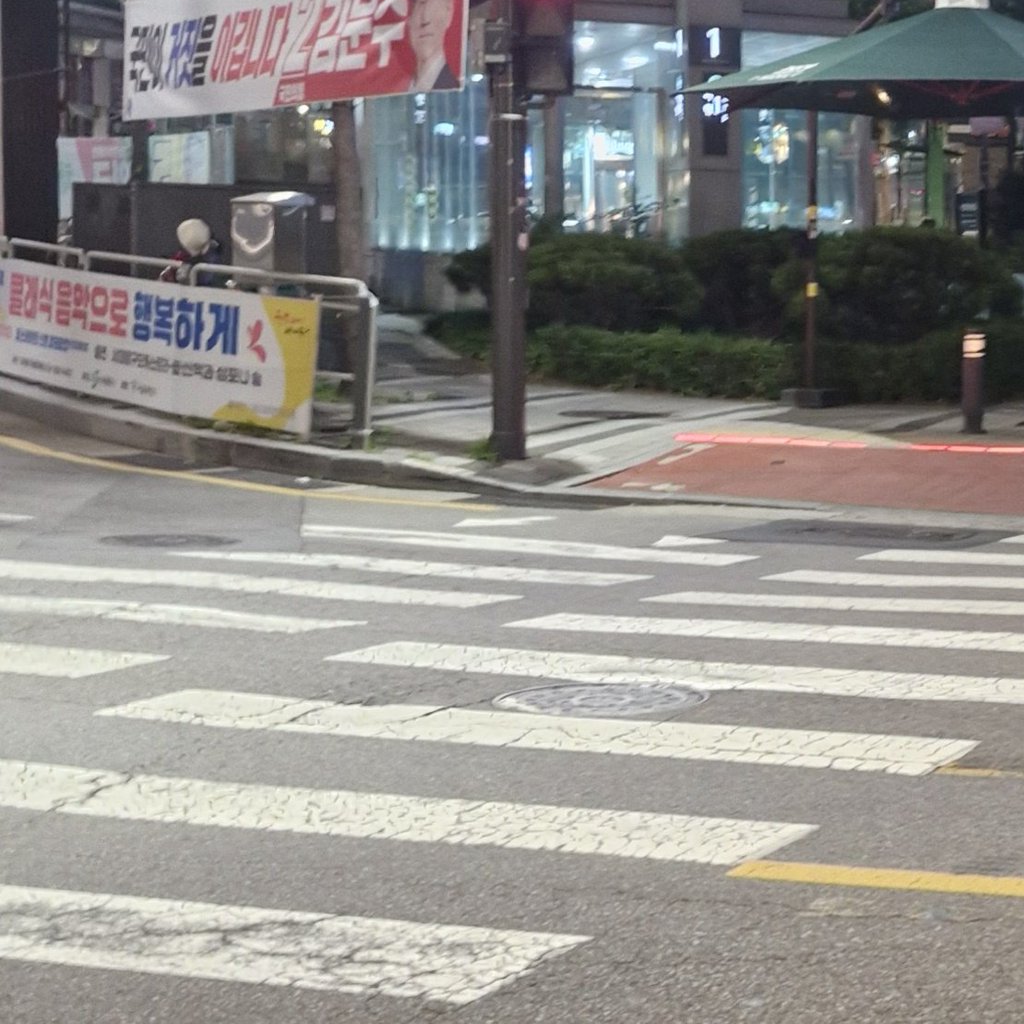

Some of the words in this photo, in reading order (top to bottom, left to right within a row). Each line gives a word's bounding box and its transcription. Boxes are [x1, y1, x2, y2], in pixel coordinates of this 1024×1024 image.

[705, 27, 721, 59] 1
[54, 279, 129, 339] 음악으로
[132, 290, 240, 356] 행복하게
